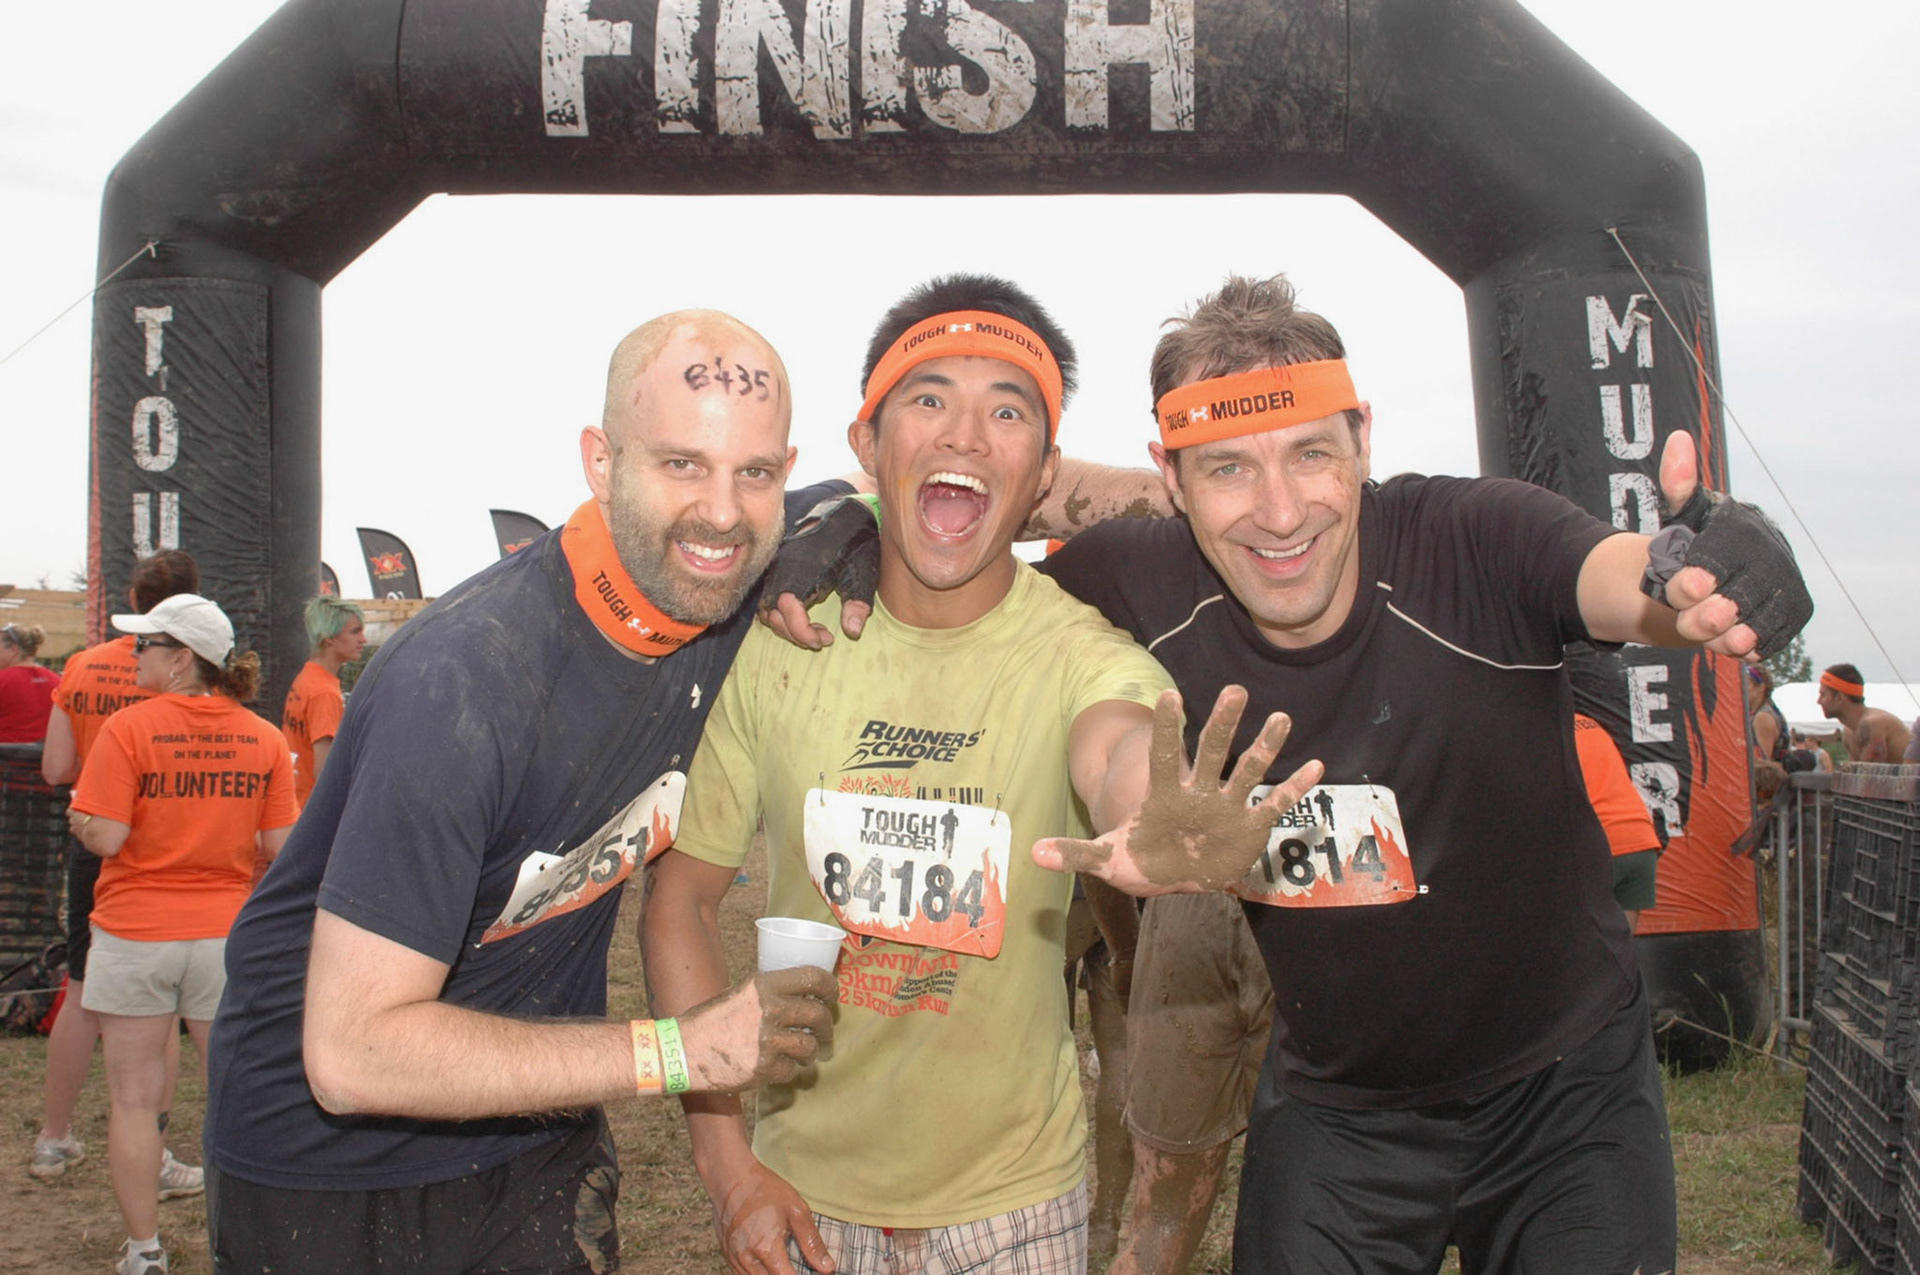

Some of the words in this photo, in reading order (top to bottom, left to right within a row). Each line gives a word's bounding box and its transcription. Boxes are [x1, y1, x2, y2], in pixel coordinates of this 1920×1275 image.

[541, 0, 1195, 139] FINISH
[903, 324, 946, 352] TOUGH
[975, 322, 1043, 361] MUDDER
[1165, 408, 1190, 432] TOUGH
[1211, 390, 1295, 421] MUDDER
[132, 305, 180, 559] TOU
[1586, 293, 1684, 838] MUDER
[592, 570, 634, 622] TOUGH
[152, 734, 195, 744] PROBABLY
[198, 734, 213, 743] THE
[215, 735, 233, 744] BEST
[236, 735, 258, 744] TEAM
[860, 720, 986, 748] RUNNERS'
[870, 742, 959, 762] CHOICE
[174, 750, 185, 759] ON
[187, 750, 201, 759] THE
[204, 750, 236, 759] PLANET
[860, 829, 937, 851] MUDDER
[862, 807, 937, 836] TOUGH
[824, 852, 986, 928] 84184
